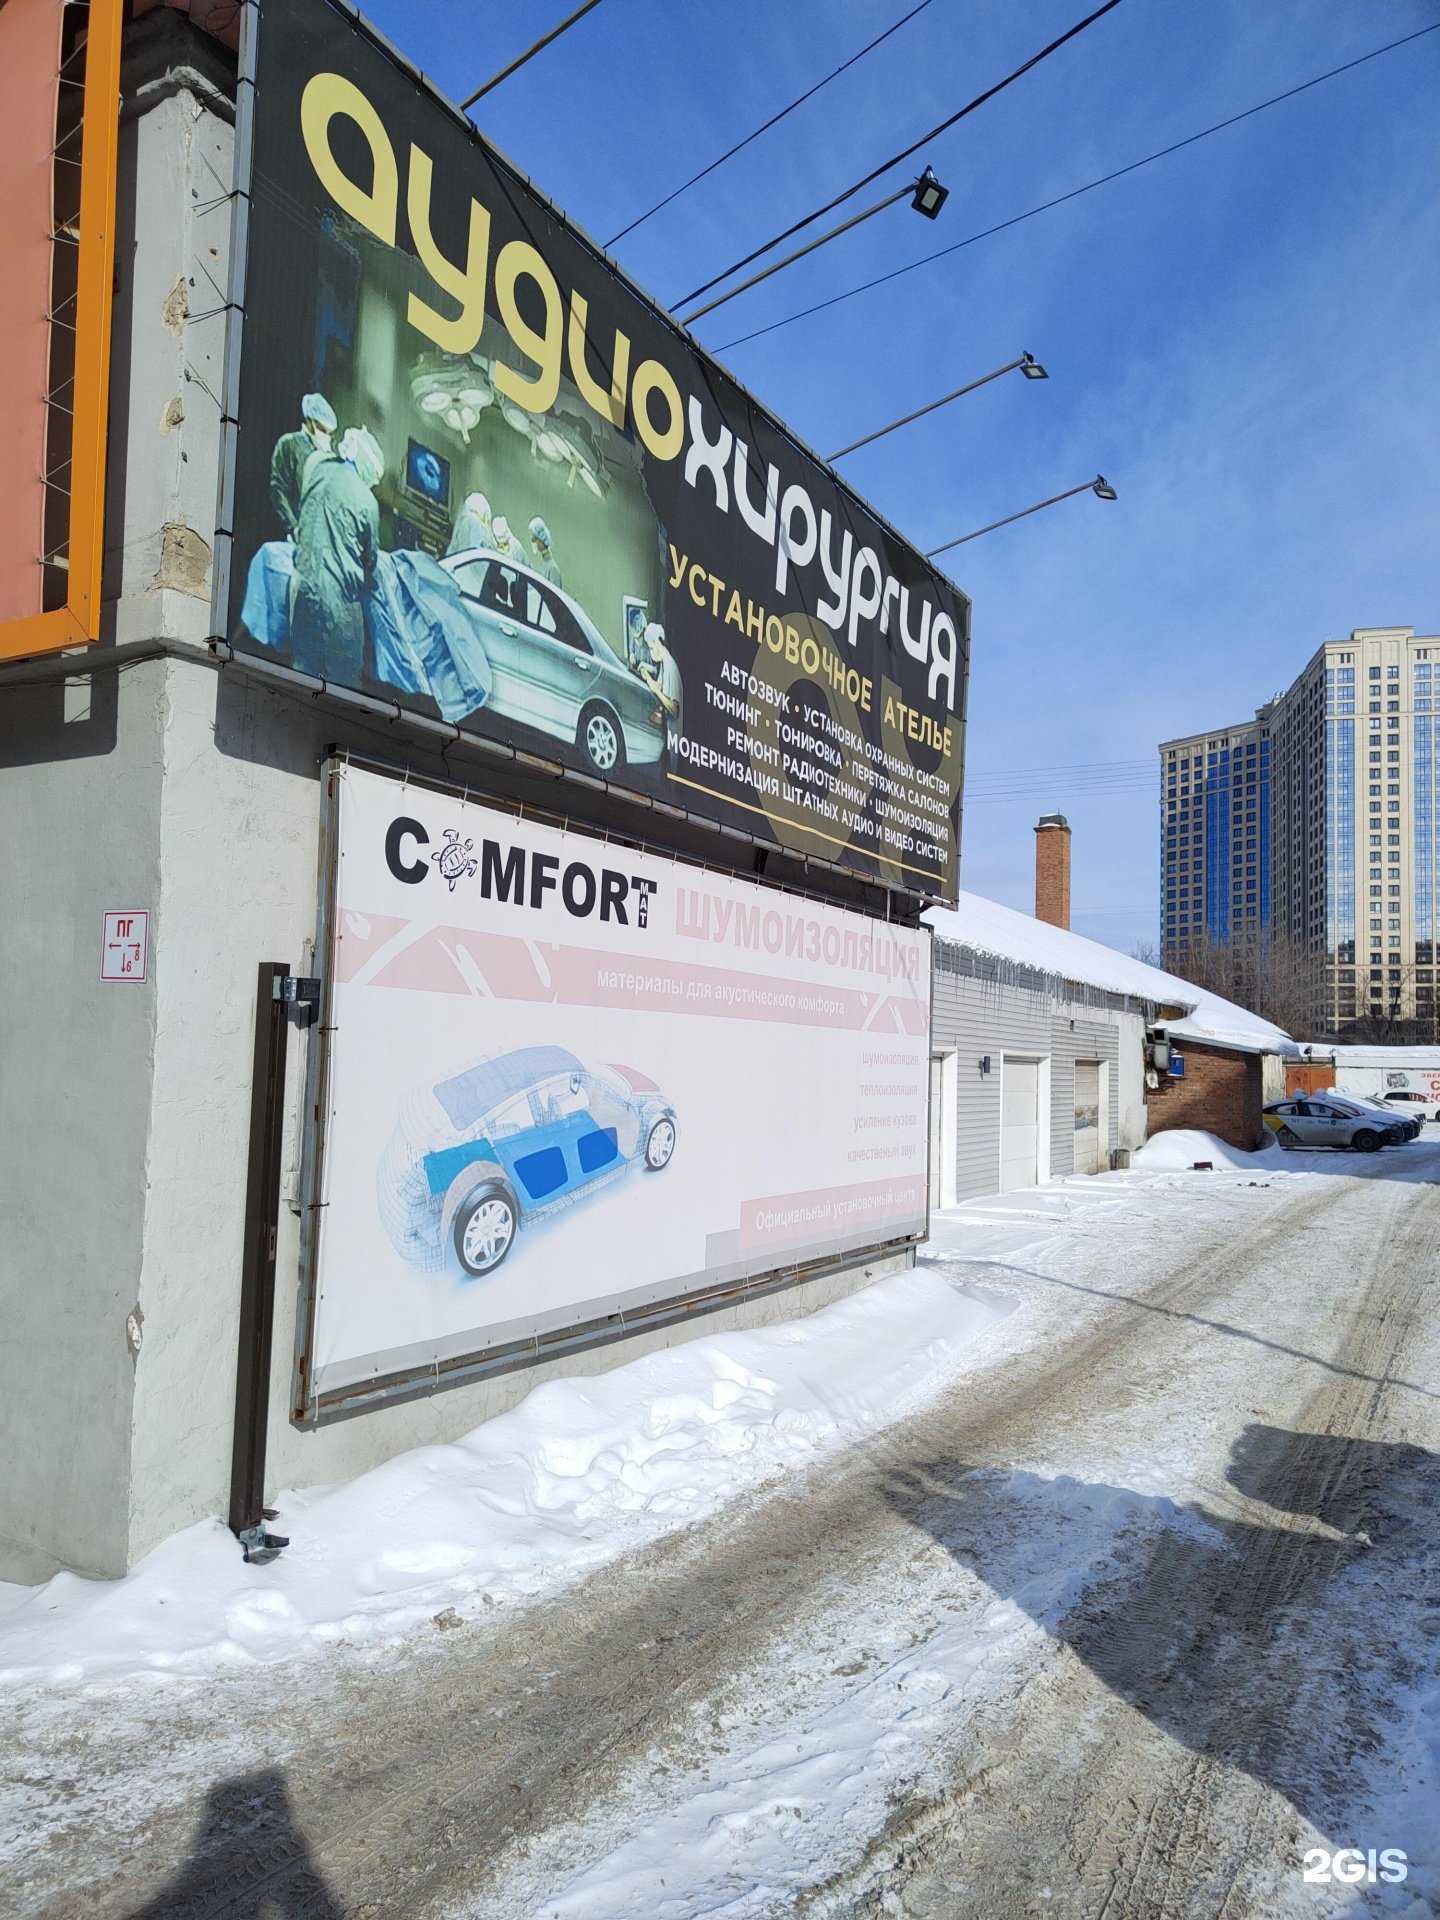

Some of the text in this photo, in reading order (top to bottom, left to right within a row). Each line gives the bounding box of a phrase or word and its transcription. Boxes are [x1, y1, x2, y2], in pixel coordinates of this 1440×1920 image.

[669, 543, 952, 757] УСТАНОВОЧНОЕ АТЕЛЬЕ
[704, 682, 950, 819] ТЮНИНГ ТОНИРОВКА ПЕРЕТЯЖКА САЛОНОВ
[720, 660, 950, 797] АВТОЗВУК УСТАНОВКА ОХРАННЫХ СИСТЕМ
[666, 730, 948, 864] МОДЕРНИЗАЦИЯ ШТАТНЫХ АУДИО И ВИДЕО СИСТЕМ
[727, 726, 949, 842] РЕМОНТ РАДИОТЕХНИКИ ШУМОИЗОЛЯЦИЯ
[116, 919, 134, 937] ПГ
[126, 961, 132, 972] 6
[676, 887, 920, 983] ШУМОИЗОЛЯЦИЯ
[597, 970, 846, 1016] материалы для акустического комфорта
[755, 1201, 831, 1232] Официальный
